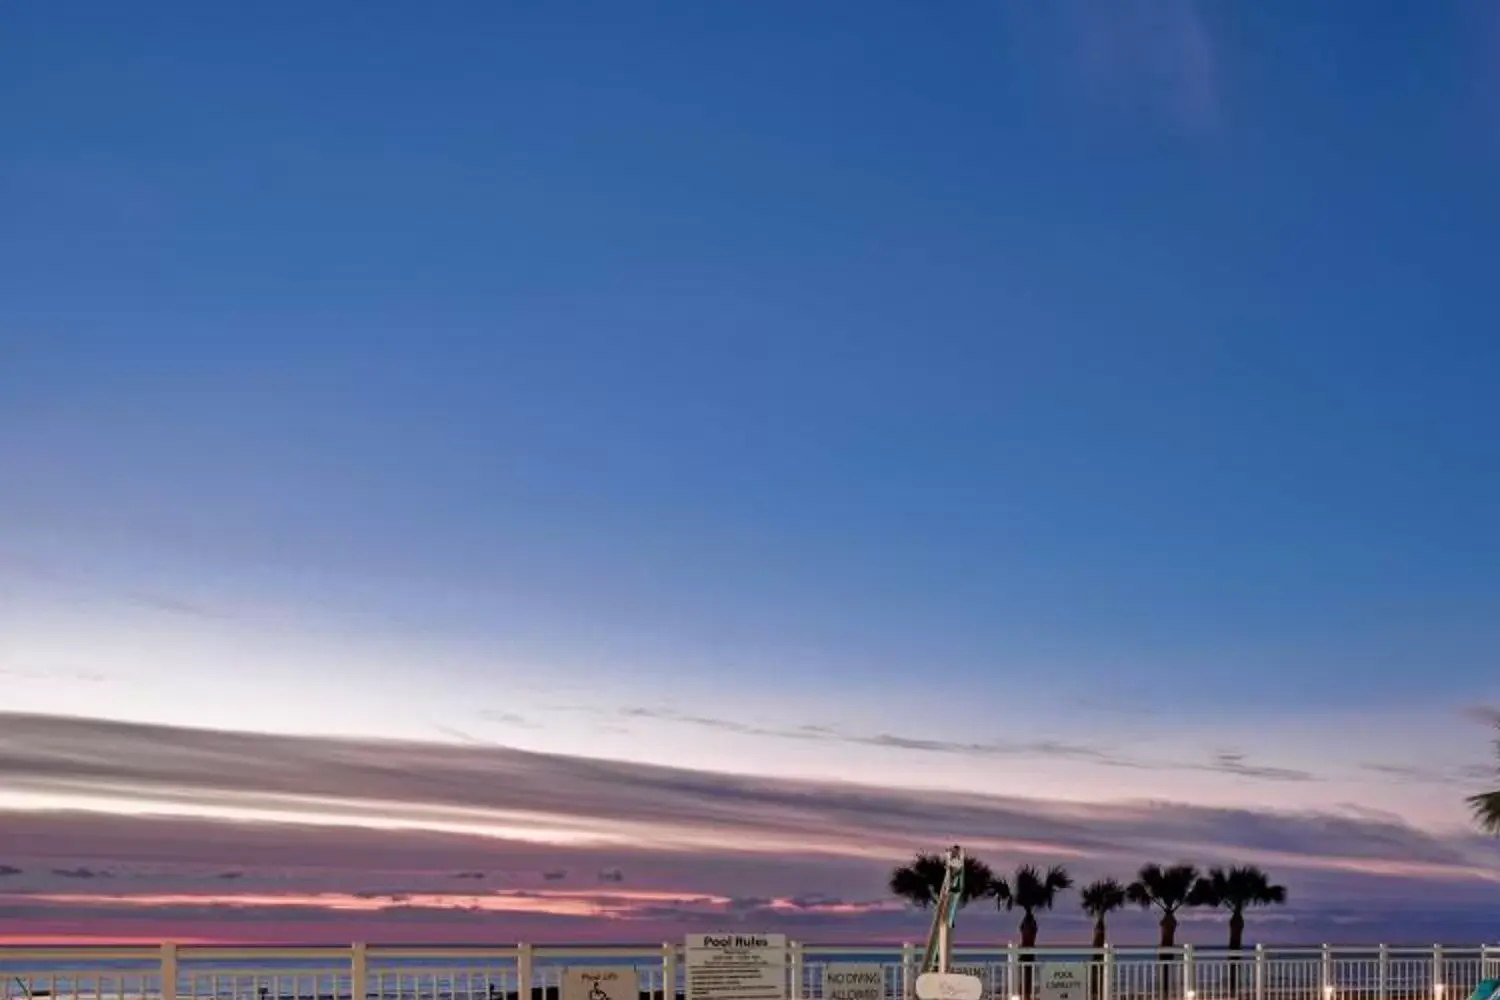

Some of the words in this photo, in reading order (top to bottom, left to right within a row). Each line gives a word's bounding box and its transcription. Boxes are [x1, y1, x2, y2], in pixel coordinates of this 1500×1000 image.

[703, 936, 732, 947] Pool
[735, 936, 769, 947] Rules
[828, 973, 845, 984] NO
[847, 972, 881, 984] DIVING
[829, 988, 879, 1000] ALLOWED
